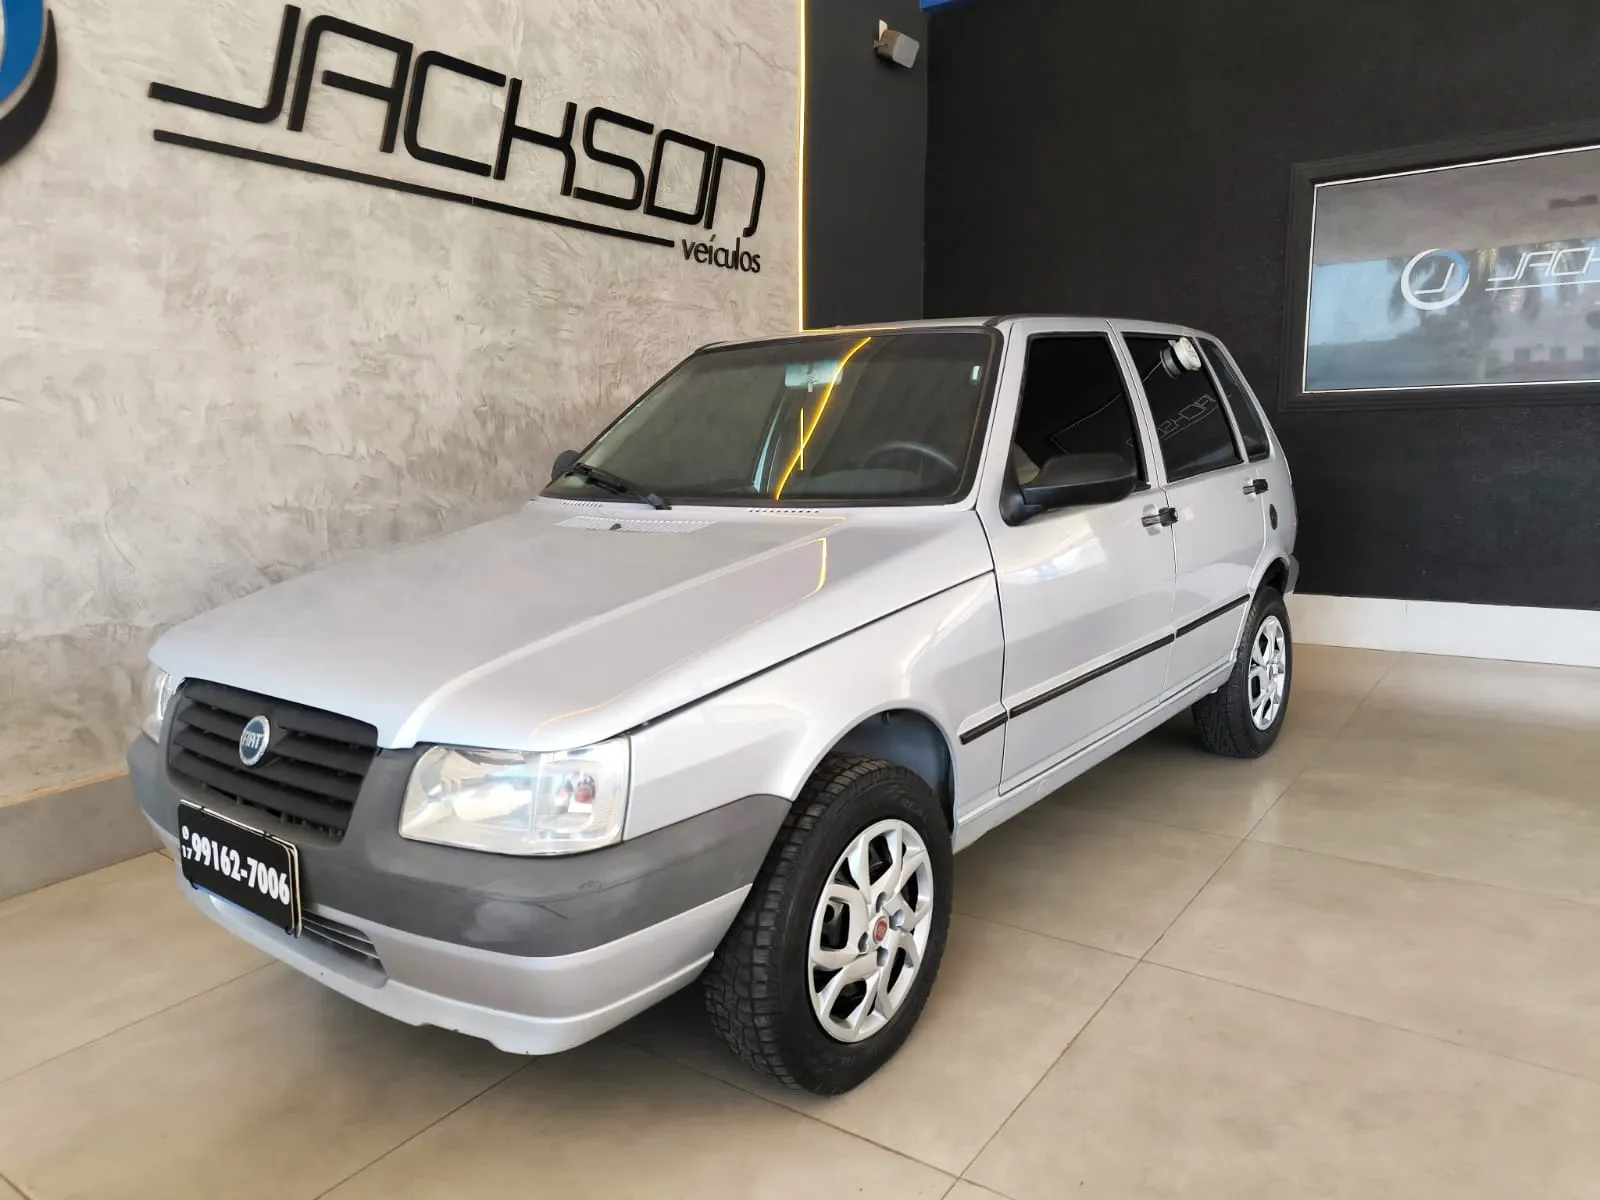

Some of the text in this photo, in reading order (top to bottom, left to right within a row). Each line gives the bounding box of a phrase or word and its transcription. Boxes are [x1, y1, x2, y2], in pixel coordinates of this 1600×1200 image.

[148, 4, 766, 238] JACKSON
[682, 235, 761, 274] veículos
[181, 833, 290, 905] 17 99162-7006
